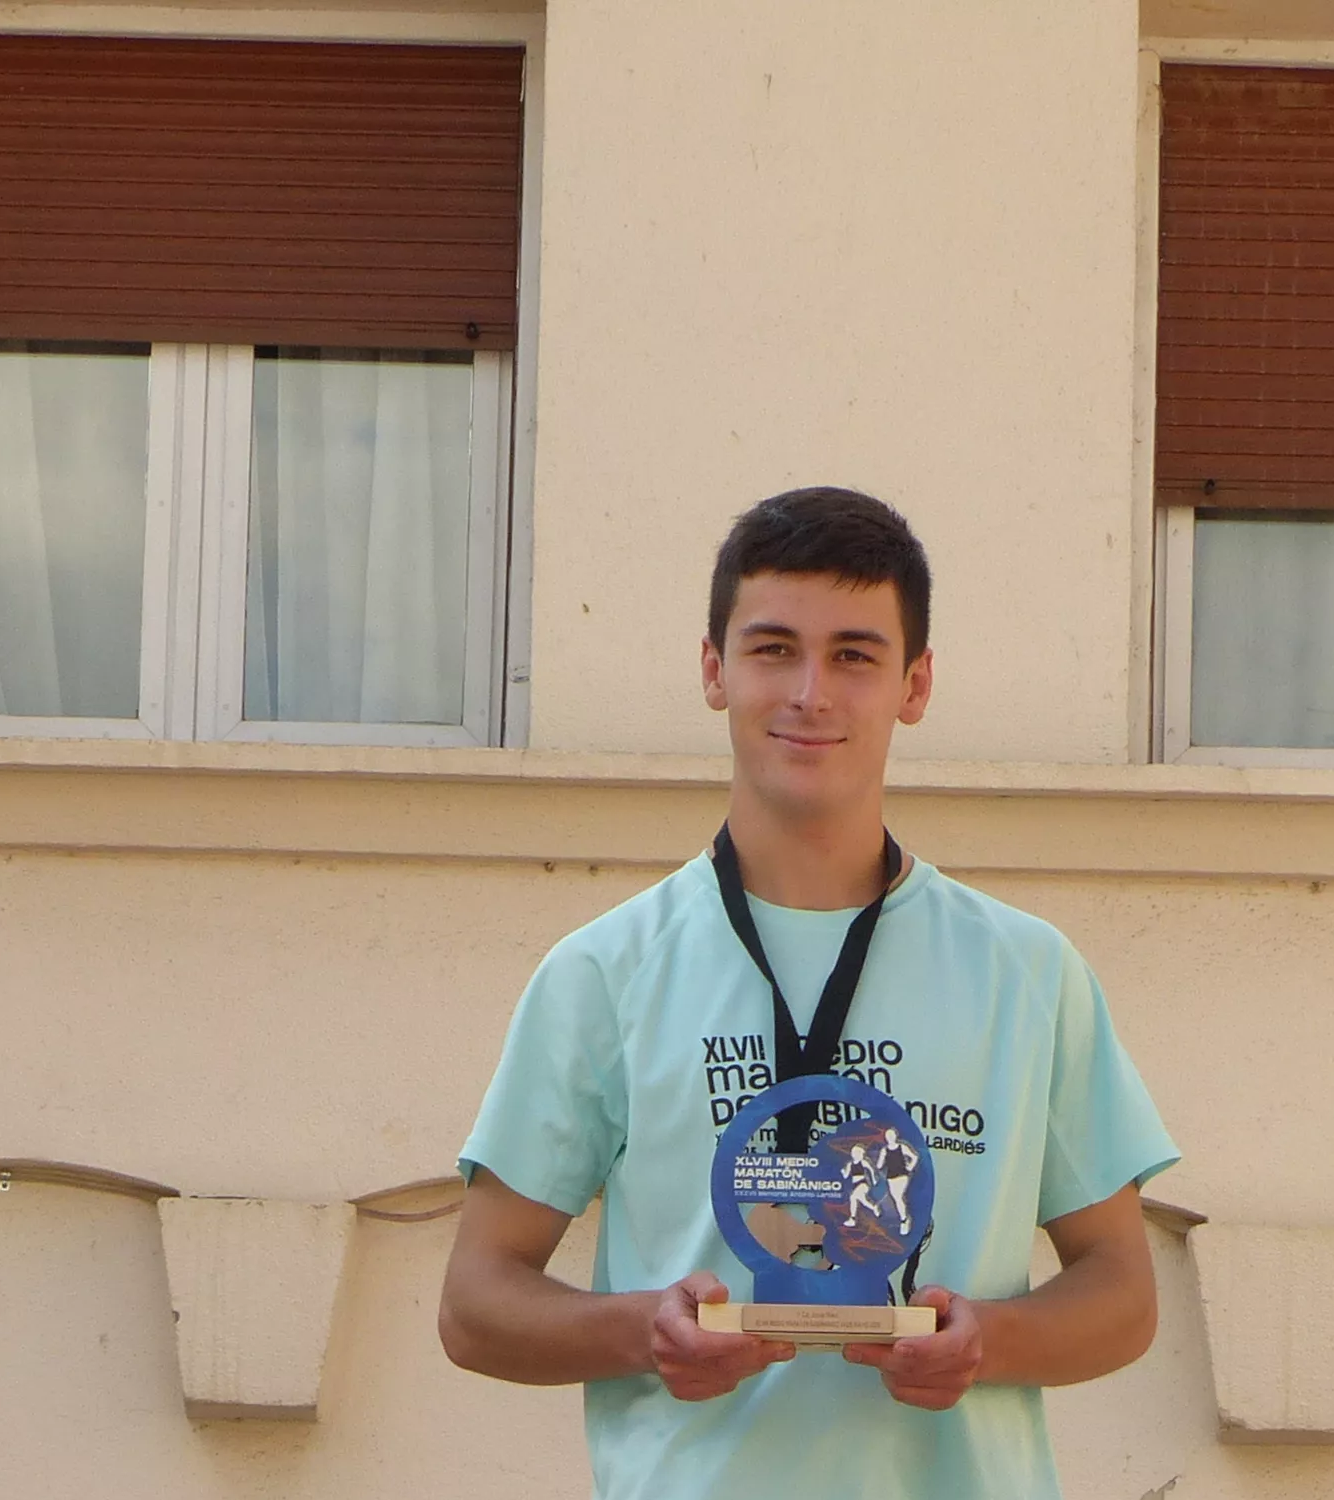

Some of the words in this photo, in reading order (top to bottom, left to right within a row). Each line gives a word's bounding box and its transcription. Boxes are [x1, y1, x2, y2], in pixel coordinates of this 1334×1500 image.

[702, 1035, 765, 1063] XLVII
[736, 1157, 771, 1166] XLVIII
[777, 1158, 819, 1167] MEDIO
[734, 1167, 802, 1178] MARATÓN
[734, 1180, 752, 1189] DE
[757, 1178, 841, 1190] SABIÑÁNIGO
